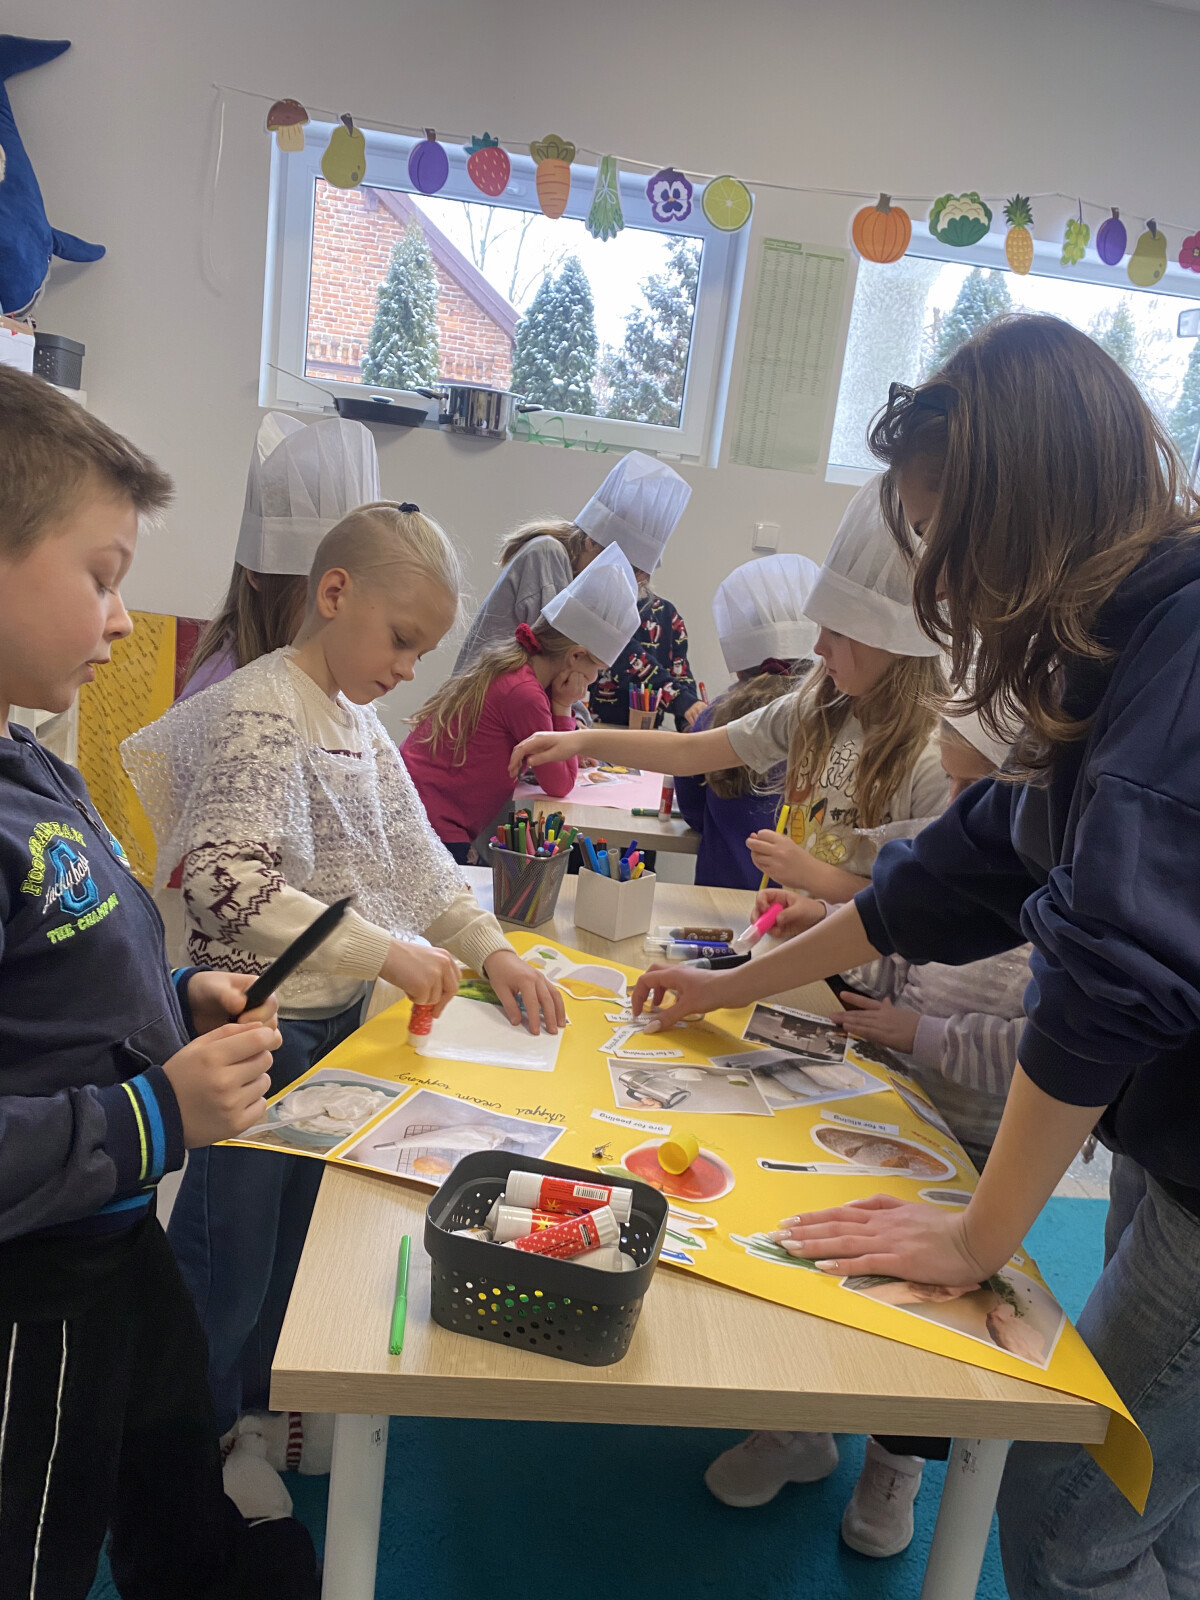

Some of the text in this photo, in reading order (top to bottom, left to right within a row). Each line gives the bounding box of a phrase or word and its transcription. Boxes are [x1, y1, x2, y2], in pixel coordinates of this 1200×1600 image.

[394, 1072, 451, 1090] topping
[456, 1092, 502, 1109] cream
[599, 1112, 632, 1125] peeling
